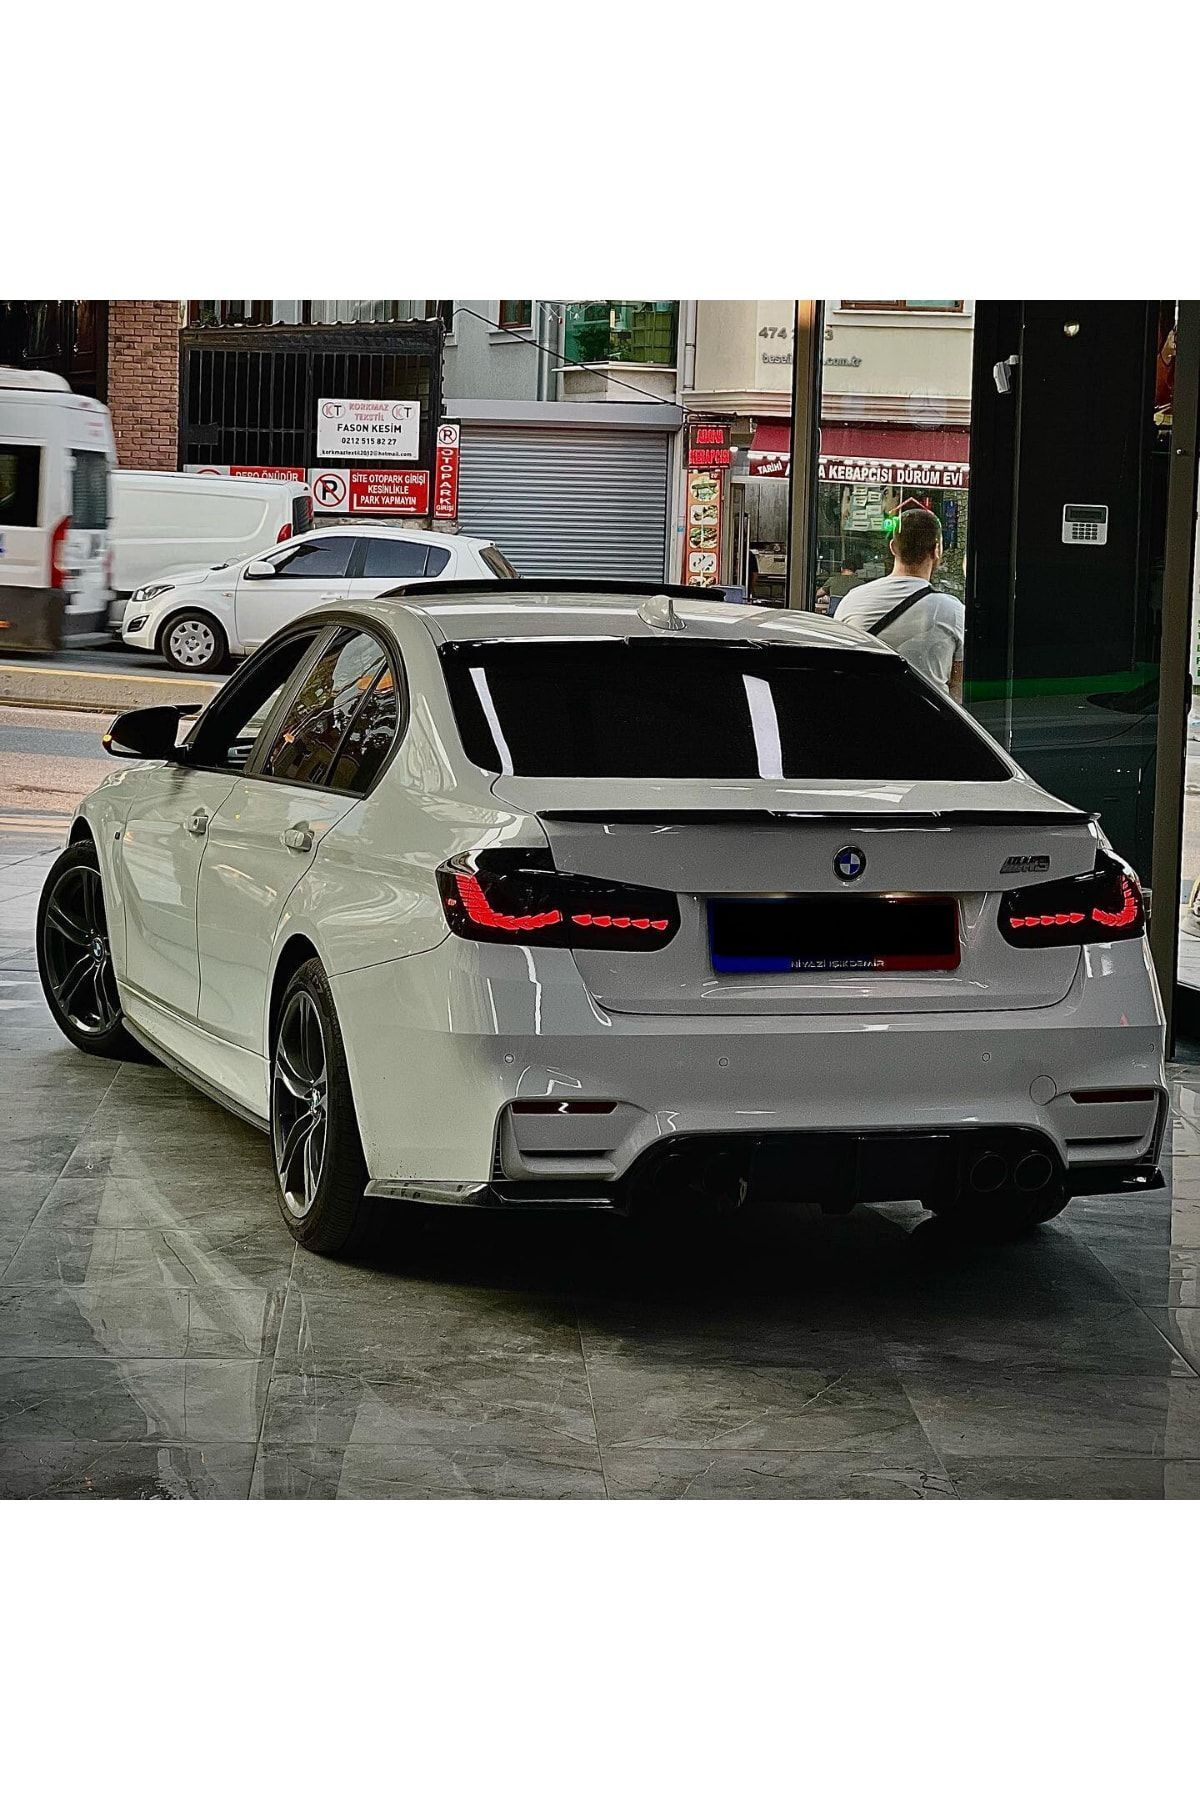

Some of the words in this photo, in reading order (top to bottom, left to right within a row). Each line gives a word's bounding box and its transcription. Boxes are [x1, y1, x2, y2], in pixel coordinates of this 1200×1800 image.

[758, 326, 787, 339] 474
[349, 403, 389, 411] KORKMAZ
[354, 412, 385, 421] TEKSTİL
[337, 423, 369, 433] FASON
[371, 423, 402, 433] KESİM
[341, 437, 360, 445] 0212
[387, 438, 397, 446] 27
[757, 461, 783, 475] TARİHİ
[352, 473, 368, 483] SİTE
[368, 475, 403, 484] OTOPARK
[404, 475, 426, 486] GİRİŞİ
[440, 448, 454, 504] OTOPARK
[896, 467, 940, 485] DÜRÜM
[943, 470, 963, 486] EVİ
[367, 484, 409, 495] KESİNLİKLE
[360, 495, 380, 505] PARK
[381, 496, 416, 506] YAPMAYIN
